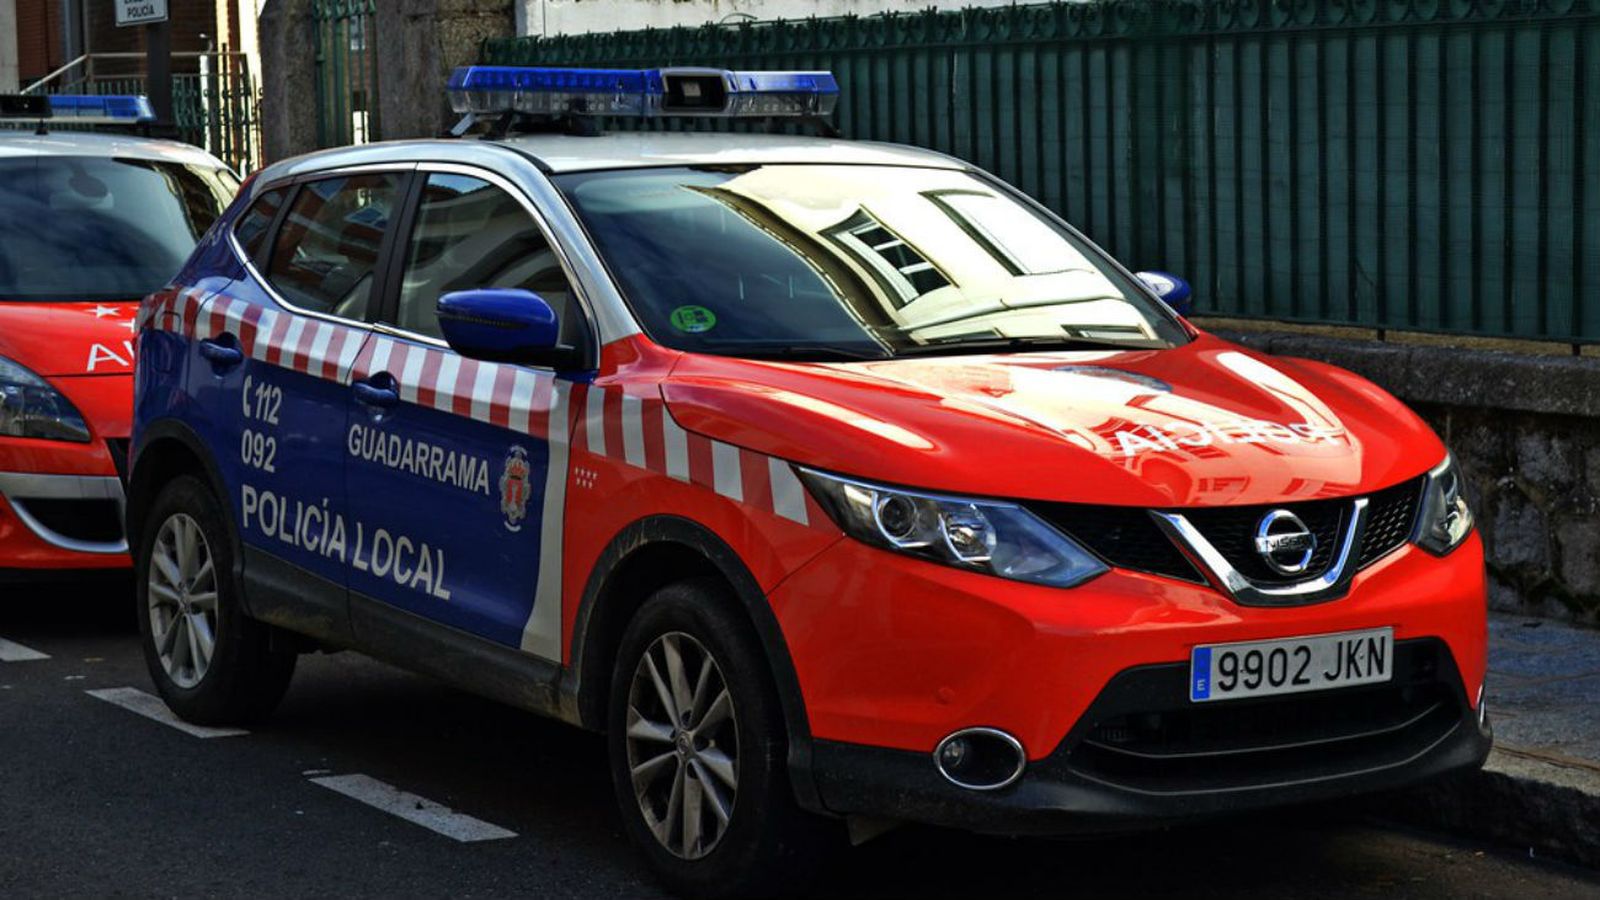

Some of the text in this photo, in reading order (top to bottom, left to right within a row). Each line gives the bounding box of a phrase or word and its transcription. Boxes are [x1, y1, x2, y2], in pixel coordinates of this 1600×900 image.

[255, 381, 282, 425] 112
[241, 429, 276, 473] 092
[348, 424, 490, 495] GUADARRAMA
[242, 484, 450, 600] POLICÍA LOCAL
[1197, 679, 1206, 691] E
[1218, 635, 1386, 692] 9902 JKN
